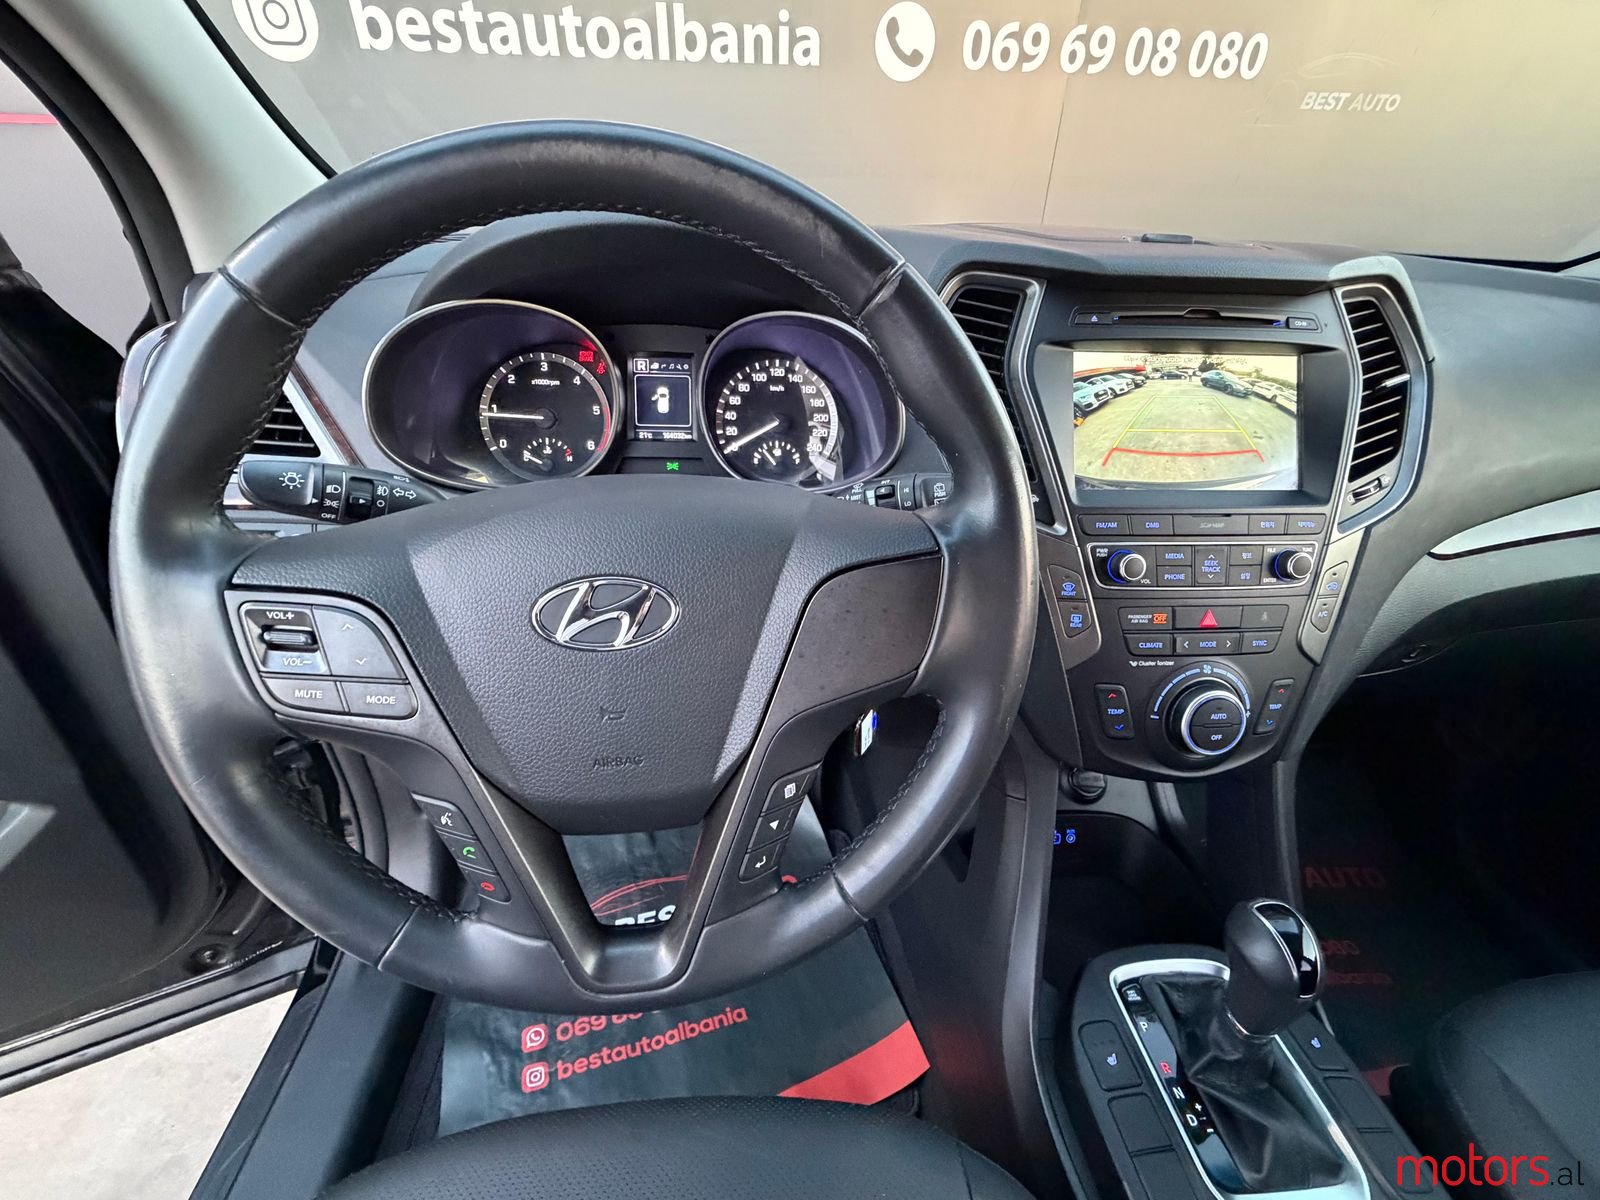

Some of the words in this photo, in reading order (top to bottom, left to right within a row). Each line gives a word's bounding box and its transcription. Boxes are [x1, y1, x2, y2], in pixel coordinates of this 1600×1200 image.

[350, 0, 821, 66] bestautoalbania
[962, 20, 1051, 73] 069
[1059, 24, 1117, 75] 69
[1124, 27, 1182, 77] 08
[1188, 30, 1268, 80] 080
[1300, 90, 1350, 112] BEST
[1349, 93, 1401, 112] AUTO
[540, 362, 549, 372] 3
[637, 360, 647, 371] R
[769, 368, 785, 377] 120
[507, 375, 516, 384] 2
[573, 375, 581, 386] 4
[751, 373, 767, 382] 100
[788, 374, 803, 383] 140
[738, 383, 750, 392] 80
[801, 385, 817, 394] 160
[729, 396, 741, 405] 60
[809, 398, 825, 408] 180
[491, 404, 498, 413] 1
[592, 406, 601, 415] 5
[724, 411, 737, 420] 40
[813, 414, 829, 422] 200
[725, 427, 738, 436] 20
[812, 429, 828, 437] 220
[499, 439, 507, 448] 0
[587, 441, 596, 451] 6
[806, 443, 822, 453] 240
[1145, 521, 1160, 529] DMB
[1165, 552, 1185, 560] MEDIA
[266, 611, 295, 620] VOL+
[1318, 610, 1328, 618] A/C
[1199, 640, 1217, 648] MODE
[1252, 639, 1268, 648] SYNC
[1138, 659, 1156, 667] Cluster
[294, 689, 323, 699] MUTE
[366, 695, 396, 705] MODE
[1269, 703, 1282, 711] TEMP
[1107, 708, 1125, 716] TEMP
[1210, 734, 1223, 742] OFF
[593, 755, 644, 769] AIRBAG
[1304, 866, 1386, 888] AUTO
[556, 1014, 608, 1042] 069
[1139, 1021, 1149, 1032] P
[556, 1007, 749, 1080] bestautoalbania
[1160, 1062, 1172, 1074] R
[1172, 1086, 1185, 1100] N
[1186, 1113, 1198, 1127] D
